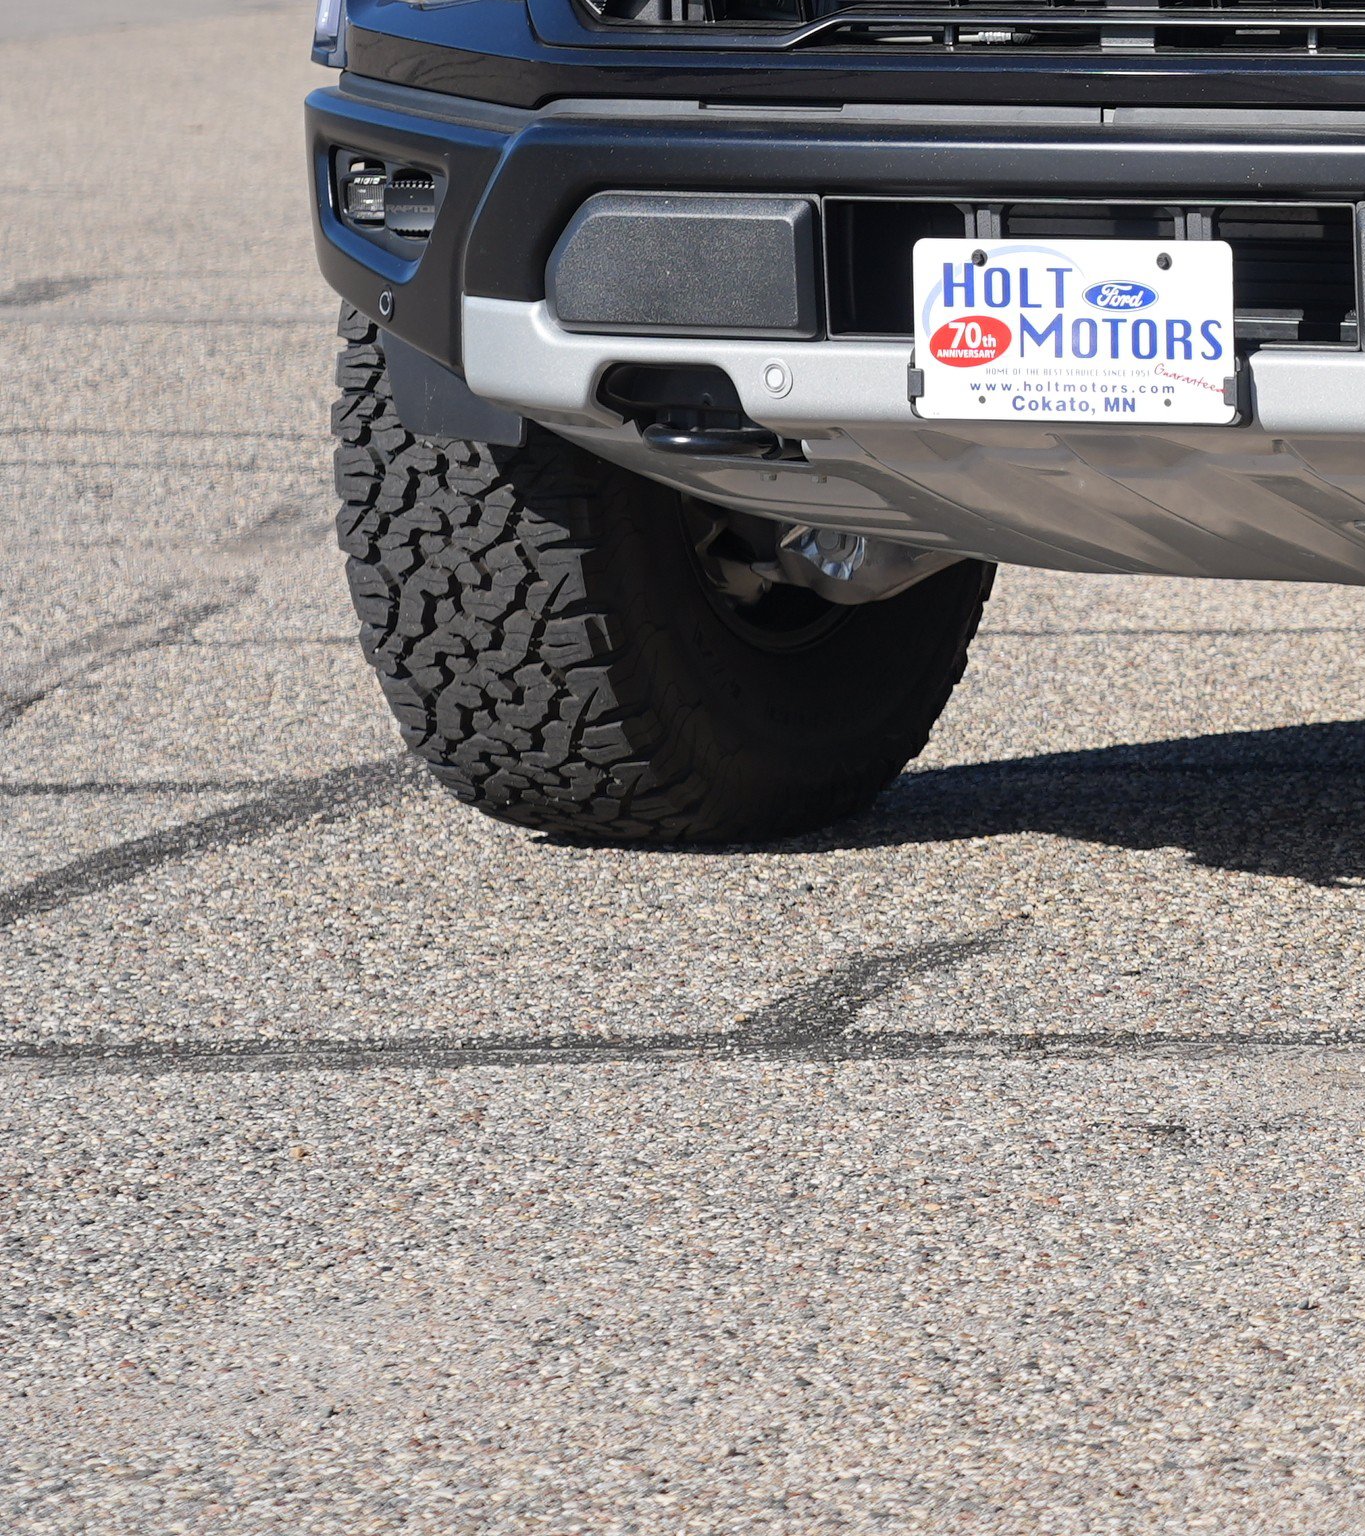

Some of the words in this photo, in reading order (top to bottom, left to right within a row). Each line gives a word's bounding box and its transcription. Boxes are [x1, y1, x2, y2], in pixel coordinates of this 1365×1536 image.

[942, 261, 1073, 309] HOLT
[1096, 283, 1144, 309] Ford
[948, 321, 997, 349] 70th
[1019, 313, 1223, 361] MOTORS
[936, 348, 997, 360] ANNIVERSARY
[985, 367, 1009, 376] HOME
[1013, 367, 1022, 376] OF
[1026, 368, 1039, 376] THE
[1043, 368, 1062, 376] BEST
[1065, 368, 1099, 377] SERVICE
[1102, 369, 1126, 377] SINCE
[1131, 369, 1150, 377] 1951
[969, 380, 1176, 395] www.holtmotors.com
[1011, 395, 1097, 416] Cokato,
[1104, 397, 1137, 413] MN
